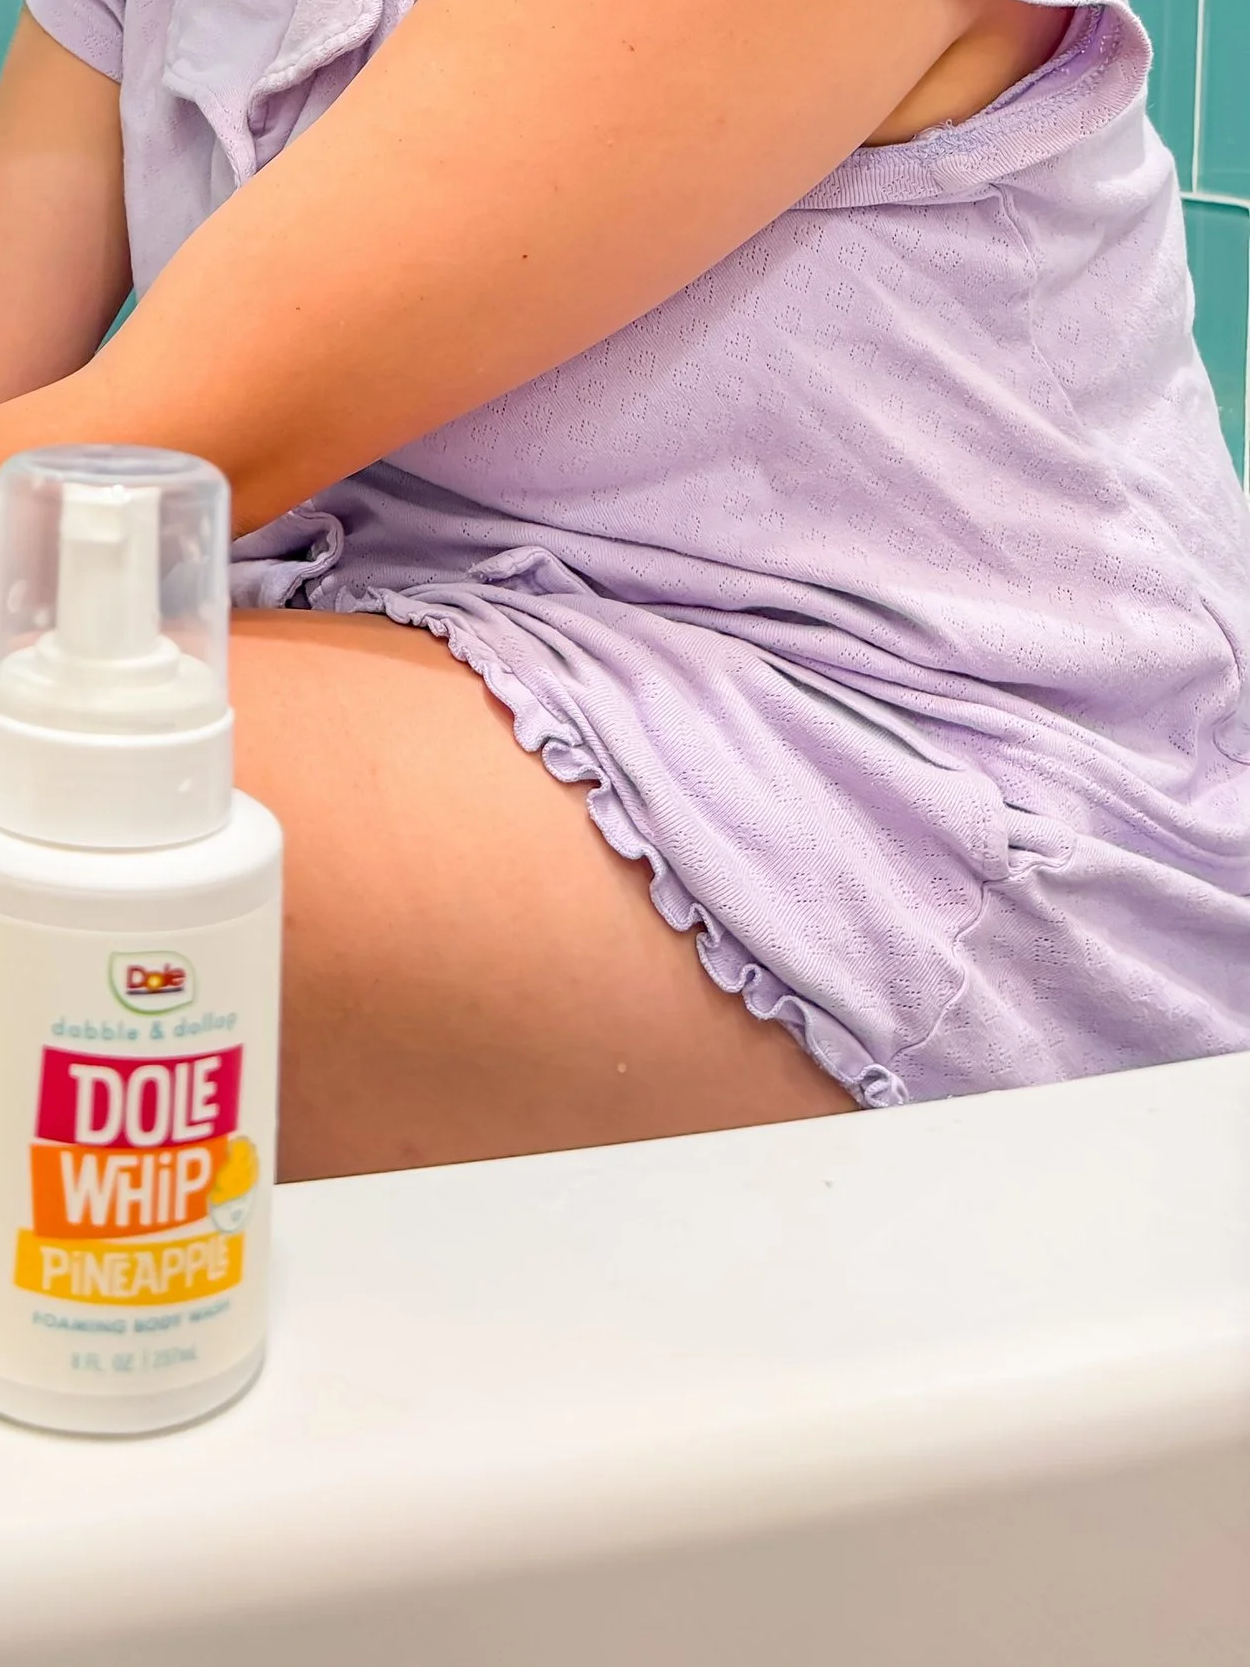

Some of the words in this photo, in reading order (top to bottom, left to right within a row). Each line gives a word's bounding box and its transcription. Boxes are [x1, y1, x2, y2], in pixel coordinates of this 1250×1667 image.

[125, 963, 186, 994] Dole
[51, 1015, 139, 1040] dabble
[149, 1019, 165, 1040] &
[173, 1011, 238, 1037] dollop
[69, 1055, 223, 1147] DOLE
[32, 1310, 127, 1333] FOAMING
[134, 1313, 181, 1333] BODY
